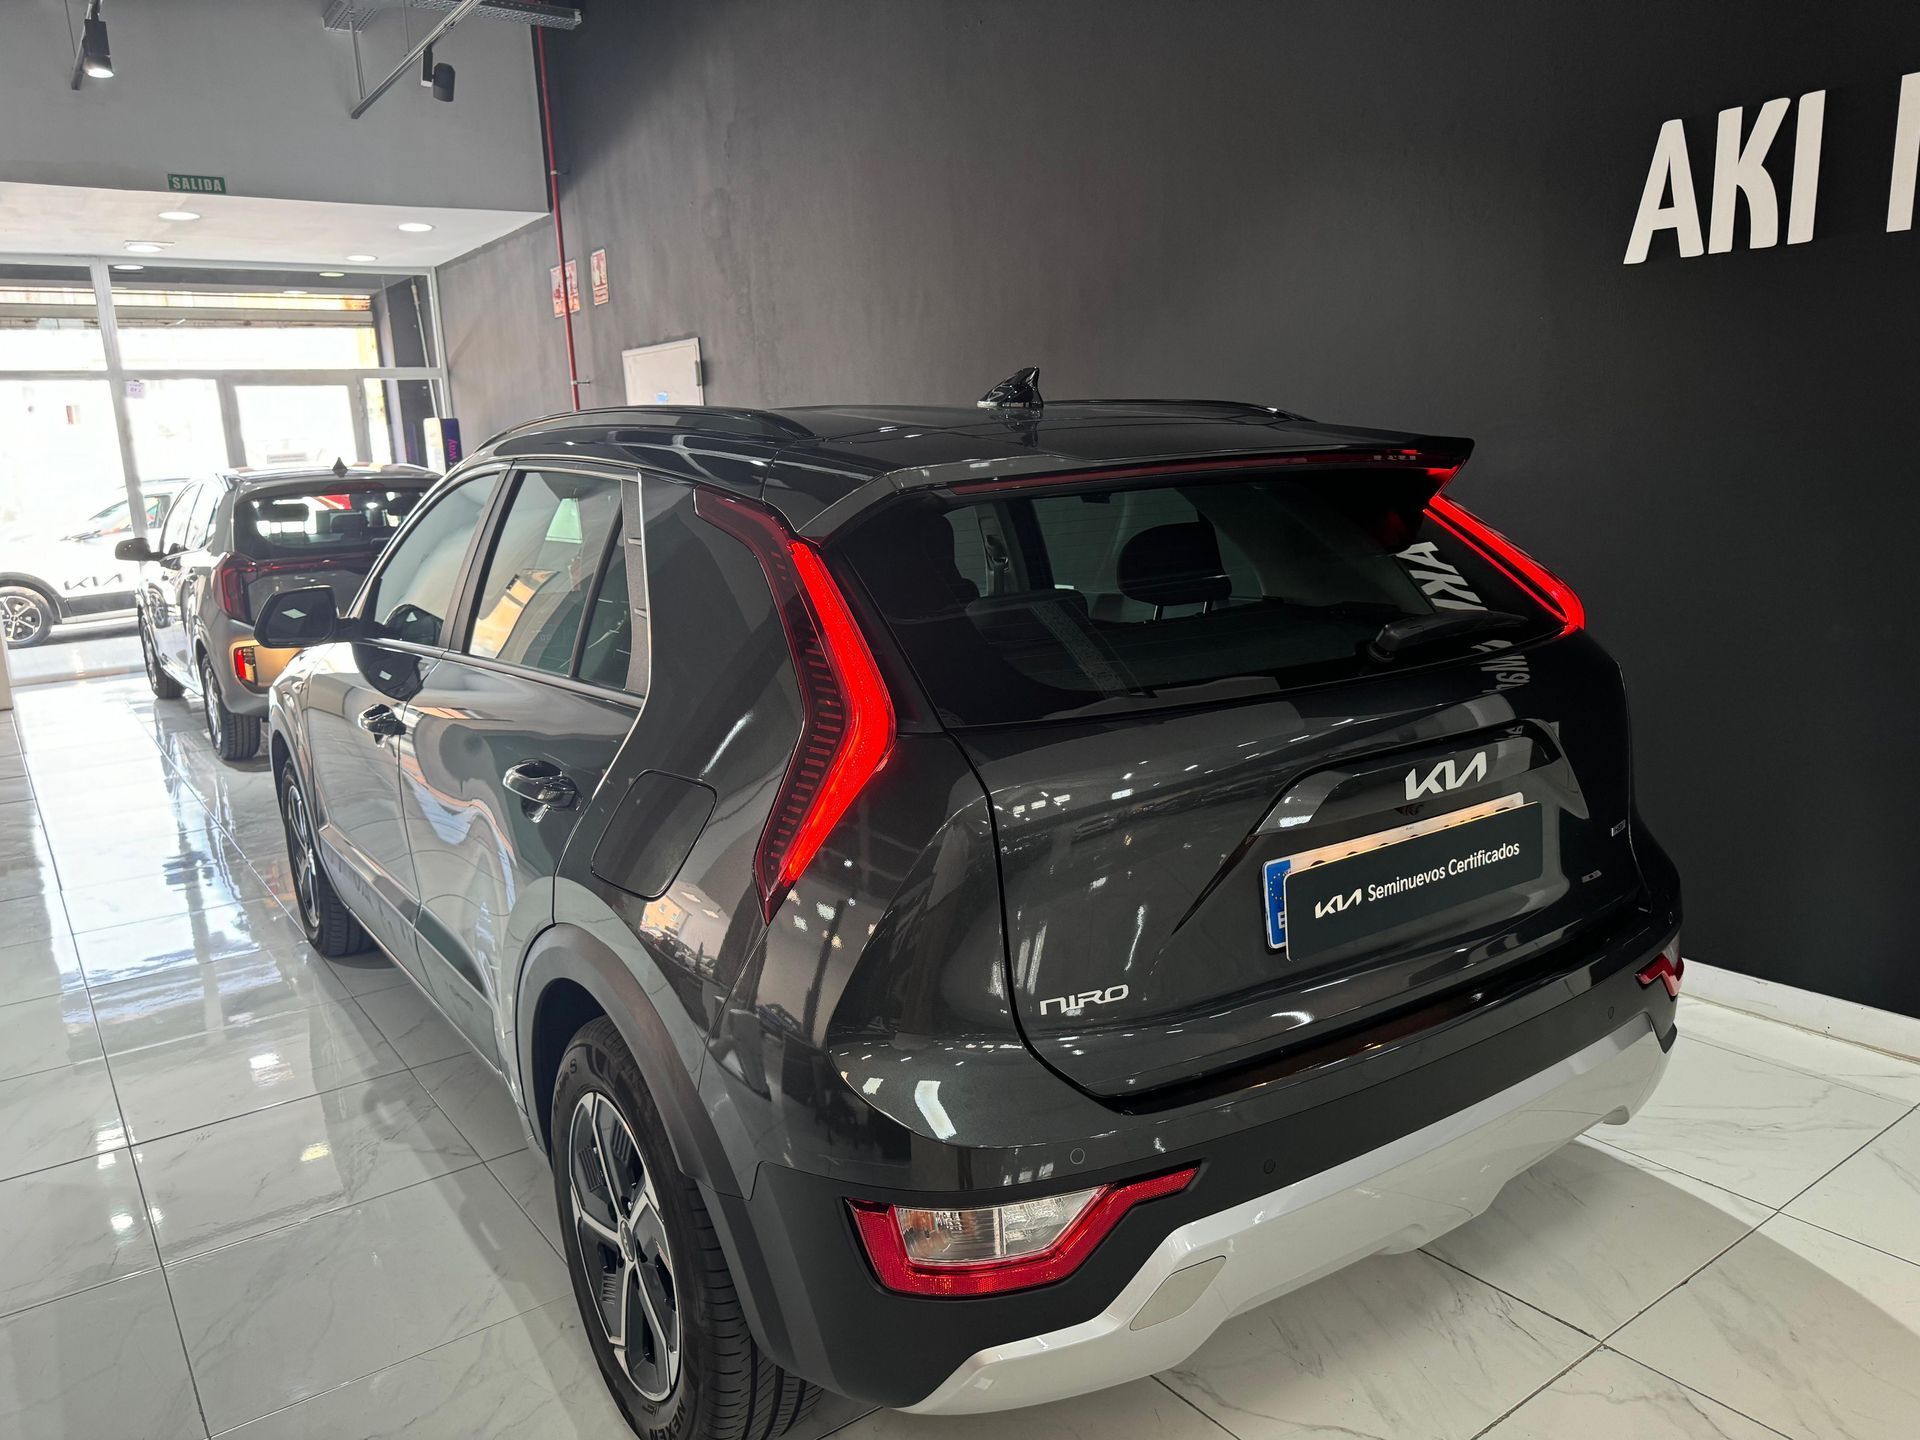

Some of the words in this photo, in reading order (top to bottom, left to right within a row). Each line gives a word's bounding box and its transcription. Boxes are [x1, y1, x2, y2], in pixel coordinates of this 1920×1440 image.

[172, 176, 222, 192] SALIDA
[1623, 89, 1826, 265] AKI
[1405, 751, 1487, 800] KIA
[1315, 888, 1362, 919] KIA
[1368, 867, 1446, 902] Seminuevos
[1448, 843, 1520, 876] Certificados
[1040, 984, 1129, 1016] NIRO
